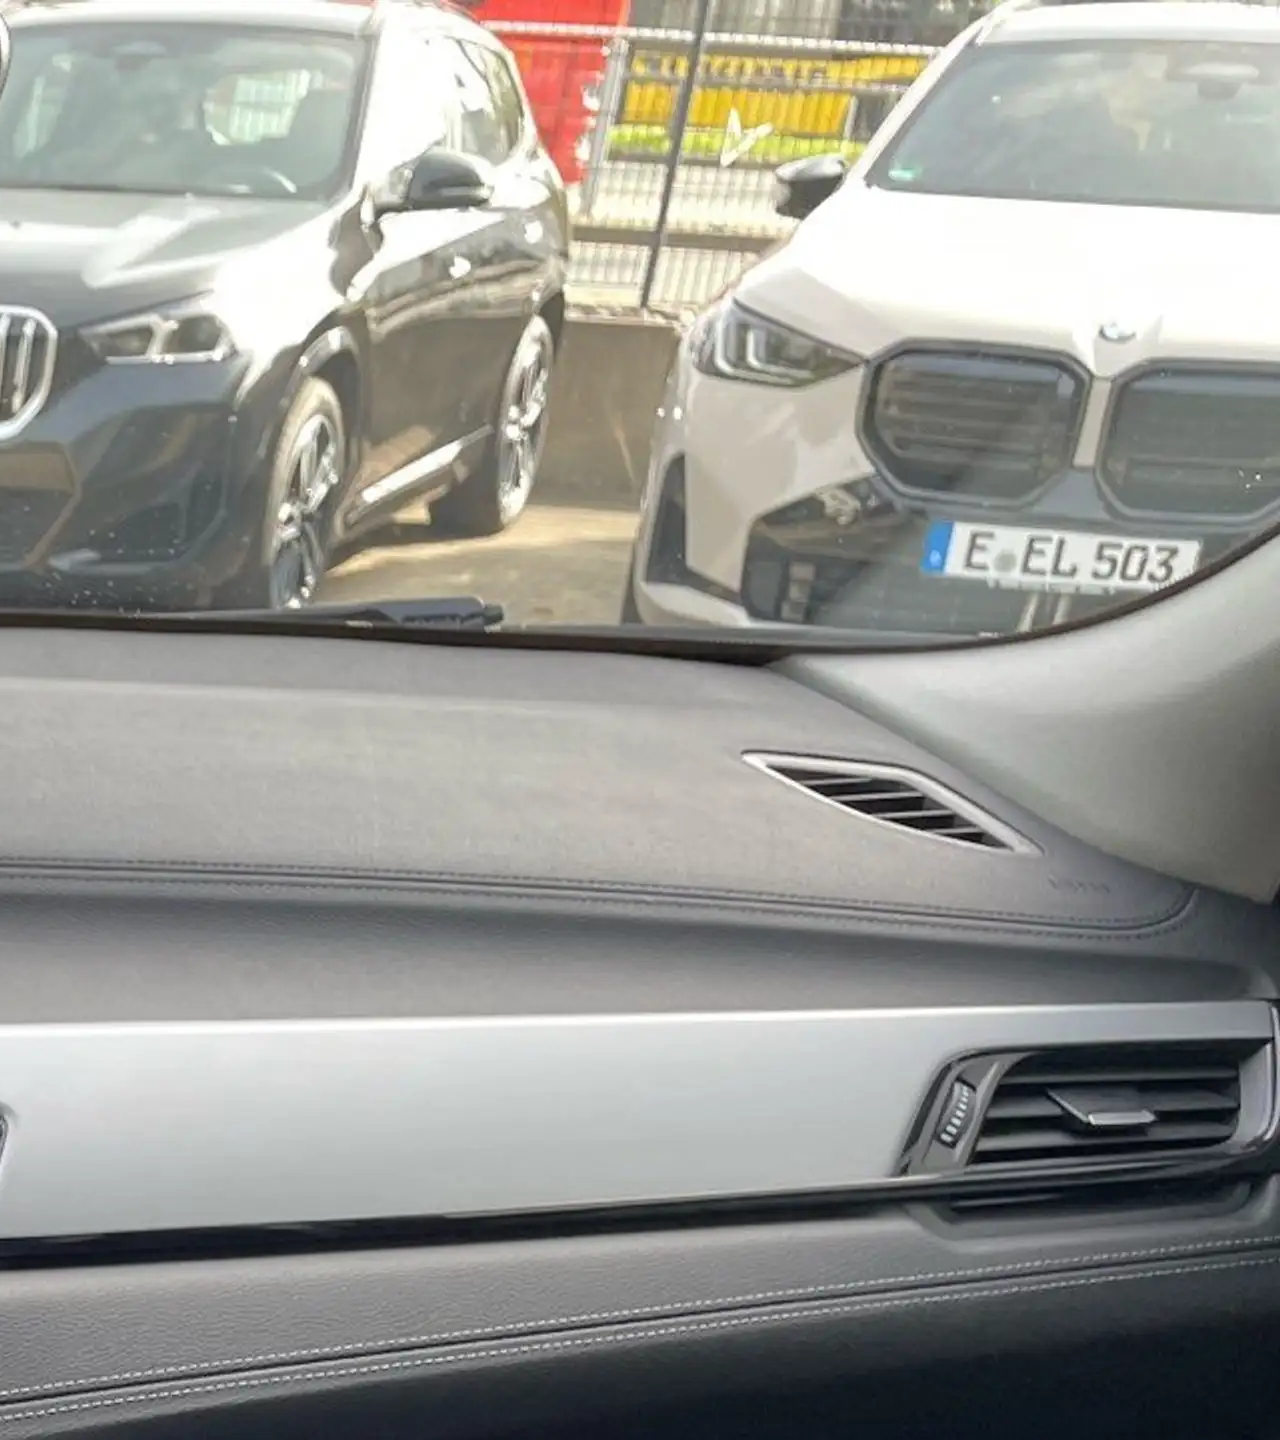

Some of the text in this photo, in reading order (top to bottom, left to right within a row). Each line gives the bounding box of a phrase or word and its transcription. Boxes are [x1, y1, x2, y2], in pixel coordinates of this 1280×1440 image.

[963, 529, 1179, 584] E EL 503
